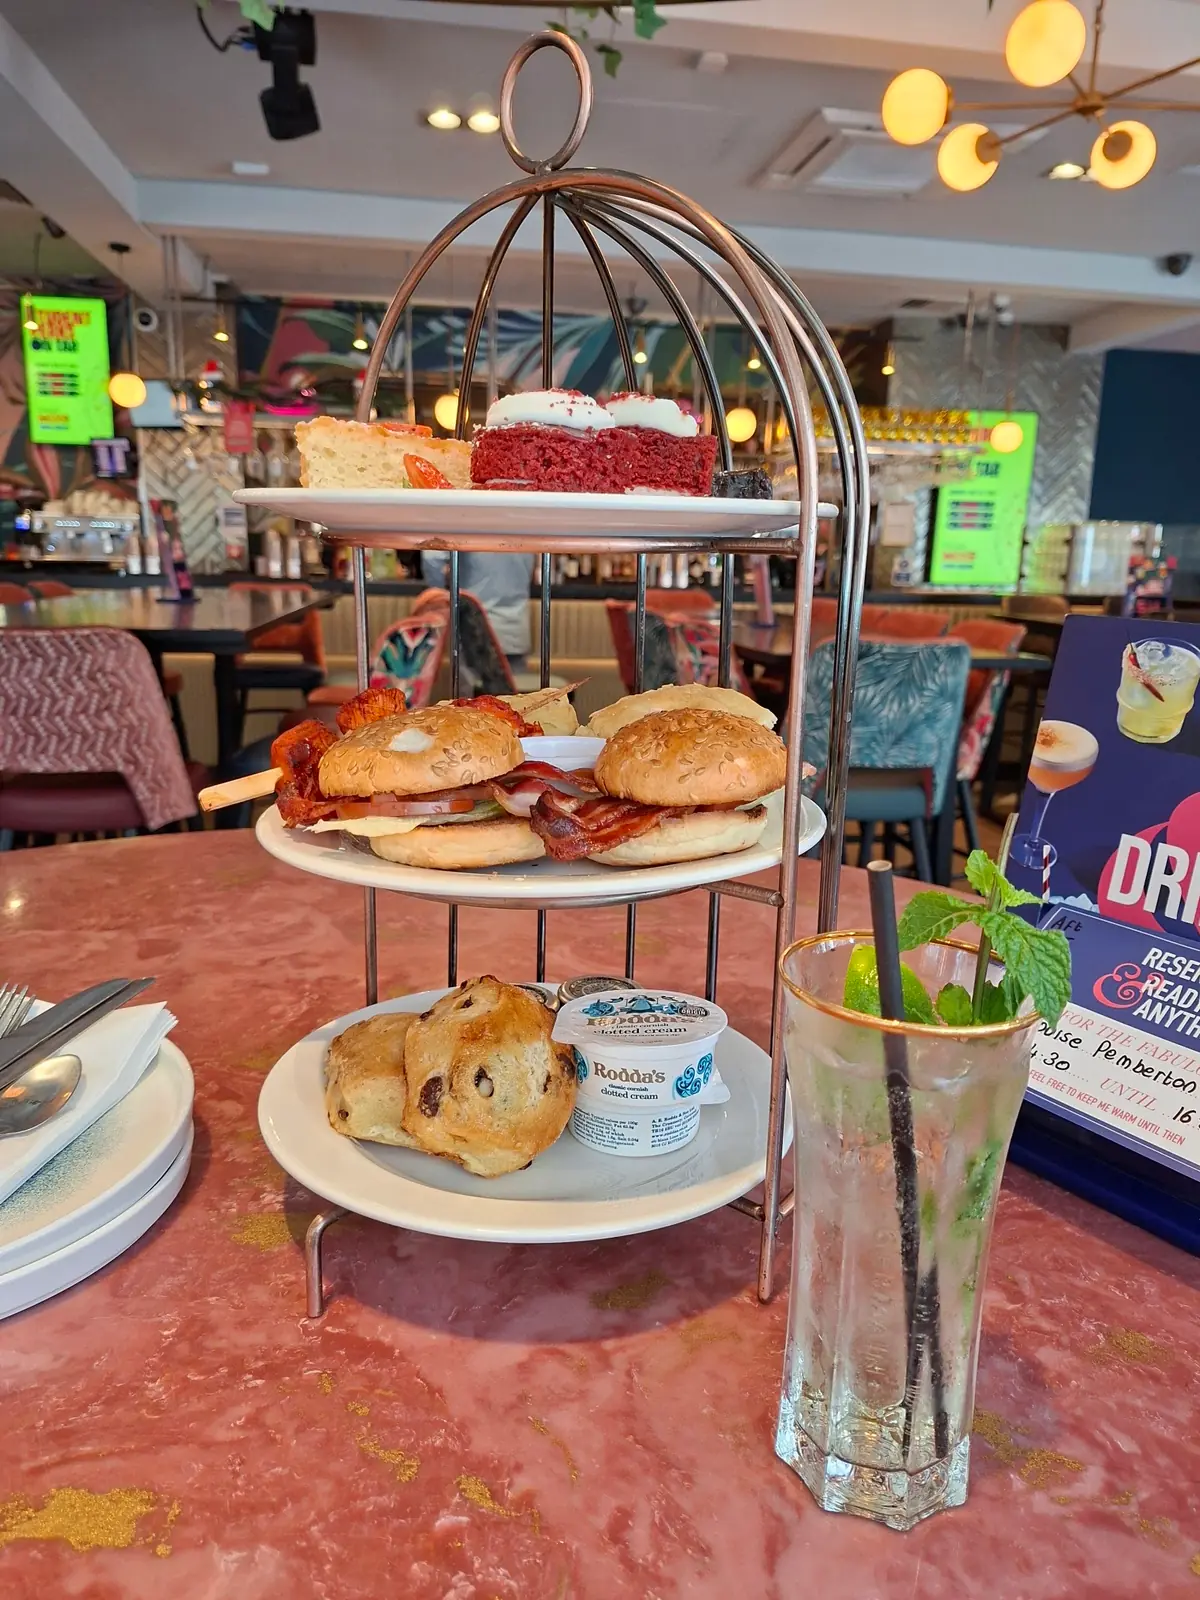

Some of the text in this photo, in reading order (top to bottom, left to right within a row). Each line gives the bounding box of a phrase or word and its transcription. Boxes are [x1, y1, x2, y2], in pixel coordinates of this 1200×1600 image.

[1106, 833, 1200, 926] DRI
[1060, 1010, 1095, 1031] FOR
[1096, 1023, 1137, 1048] THE
[593, 1061, 666, 1083] Rodda's
[1092, 1040, 1197, 1093] Pemberton
[600, 1087, 629, 1099] clotted
[1030, 1069, 1186, 1146] FEEL FREE TO KEEP ME WARM UNTIL THEN
[1100, 1077, 1157, 1111] UNTIL
